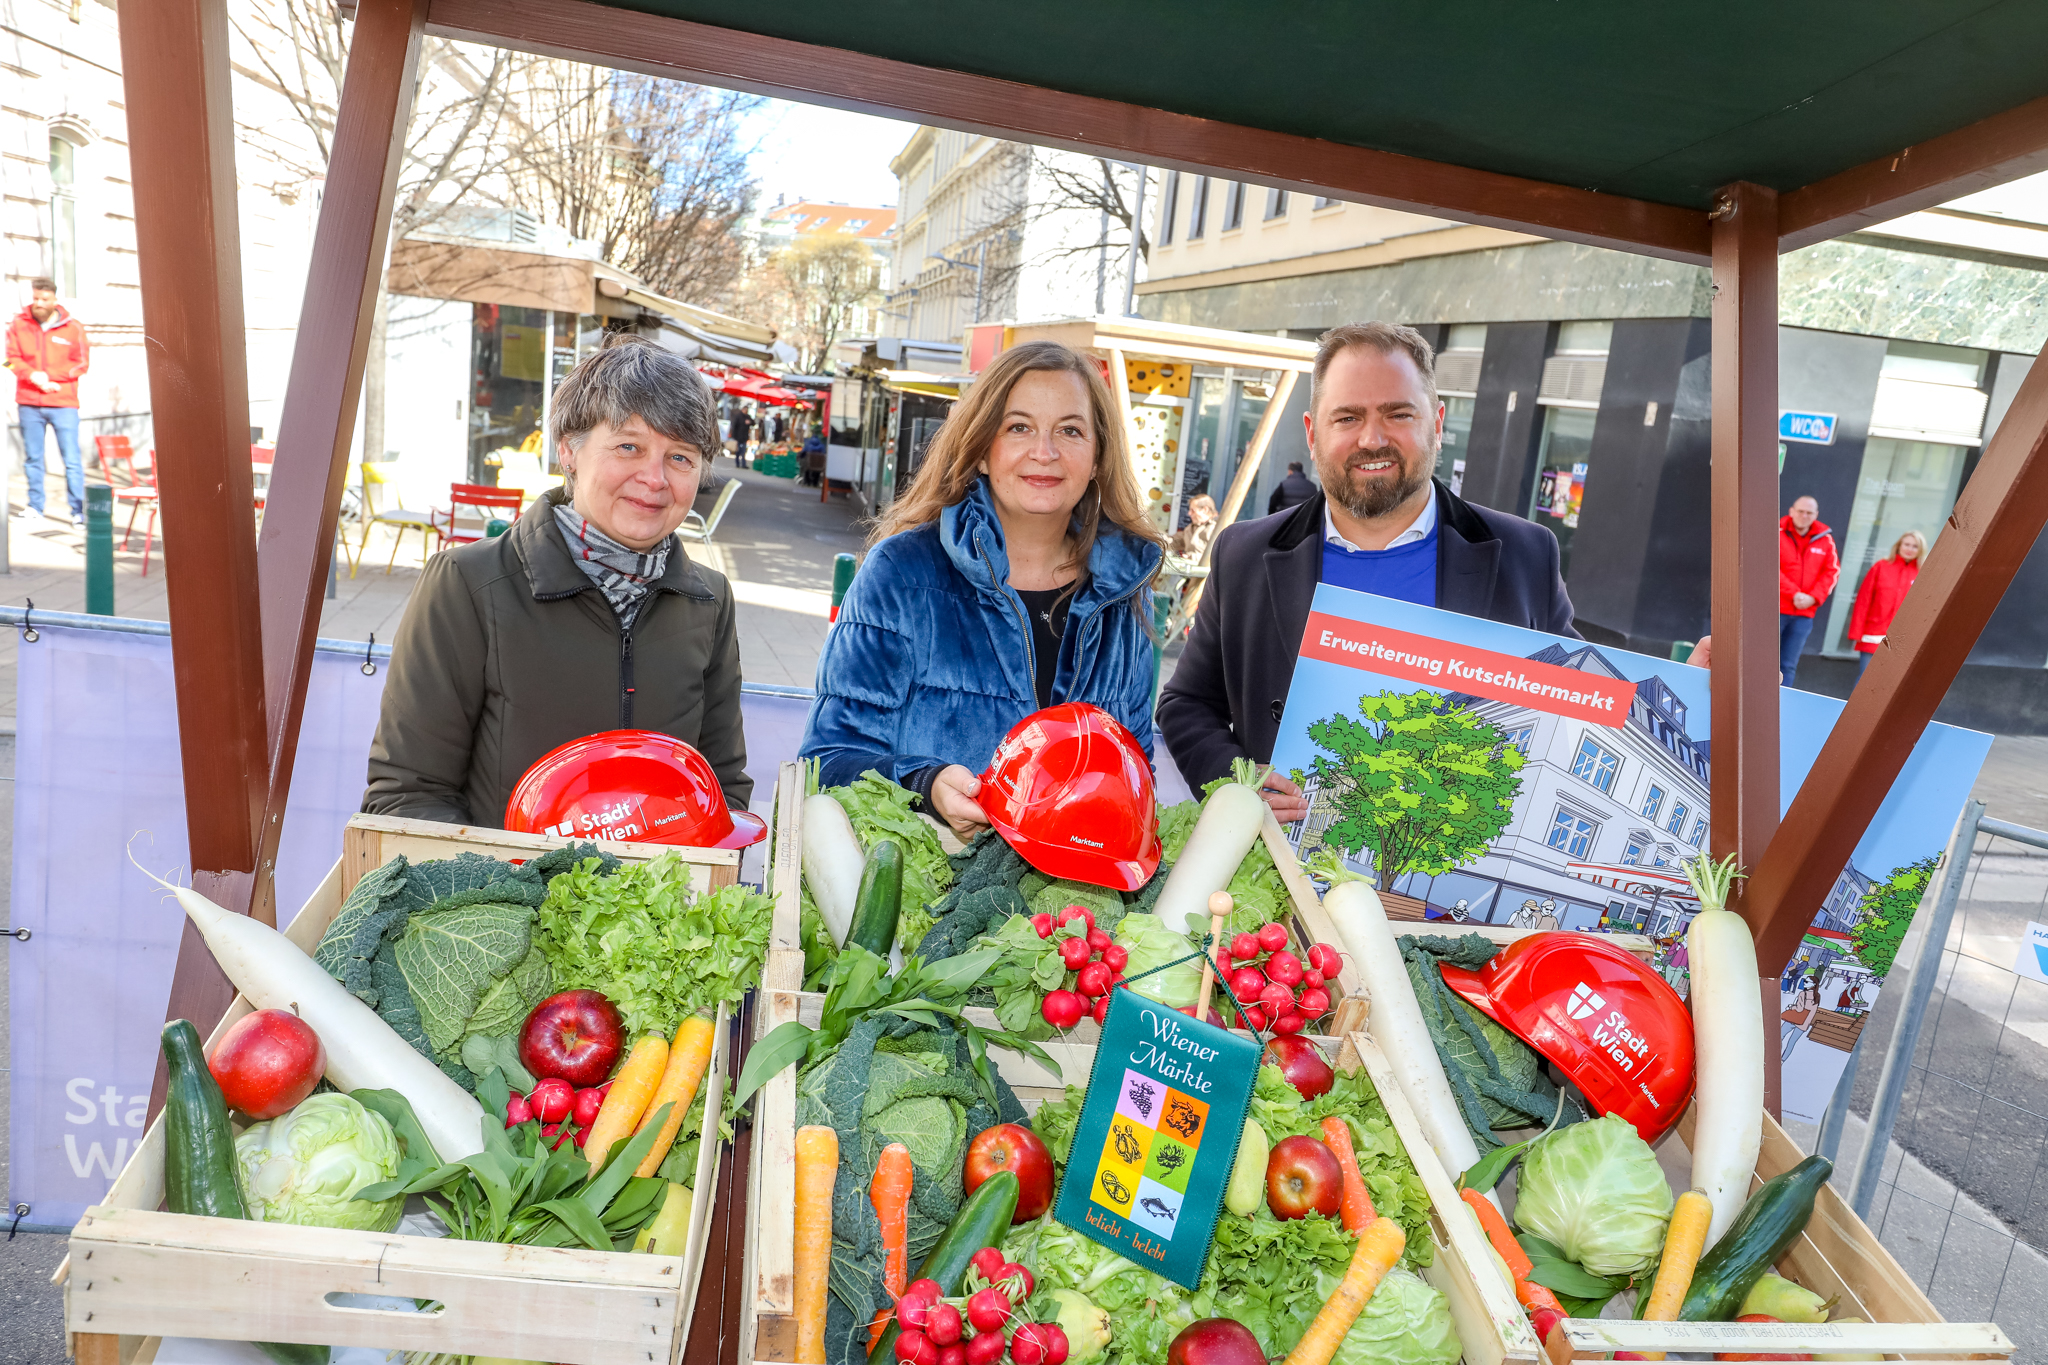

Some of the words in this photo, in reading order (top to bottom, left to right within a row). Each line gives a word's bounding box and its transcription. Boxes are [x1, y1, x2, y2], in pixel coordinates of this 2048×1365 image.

[1790, 416, 1812, 435] WC
[1319, 629, 1444, 676] Erweiterung
[1446, 658, 1615, 712] Kutschkermarkt
[1003, 774, 1022, 793] Marktamt
[580, 802, 633, 832] Stadt
[654, 810, 687, 827] Marktamt
[1070, 835, 1104, 849] Marktamt
[1140, 1009, 1219, 1063] Wiener
[1592, 1022, 1634, 1072] Wien
[1604, 1011, 1649, 1058] Stadt
[1129, 1040, 1212, 1094] Märkte
[1638, 1082, 1660, 1110] Marktamt
[1085, 1206, 1122, 1238] beliebt
[1132, 1232, 1167, 1262] belebt
[1663, 1326, 1691, 1338] 1956
